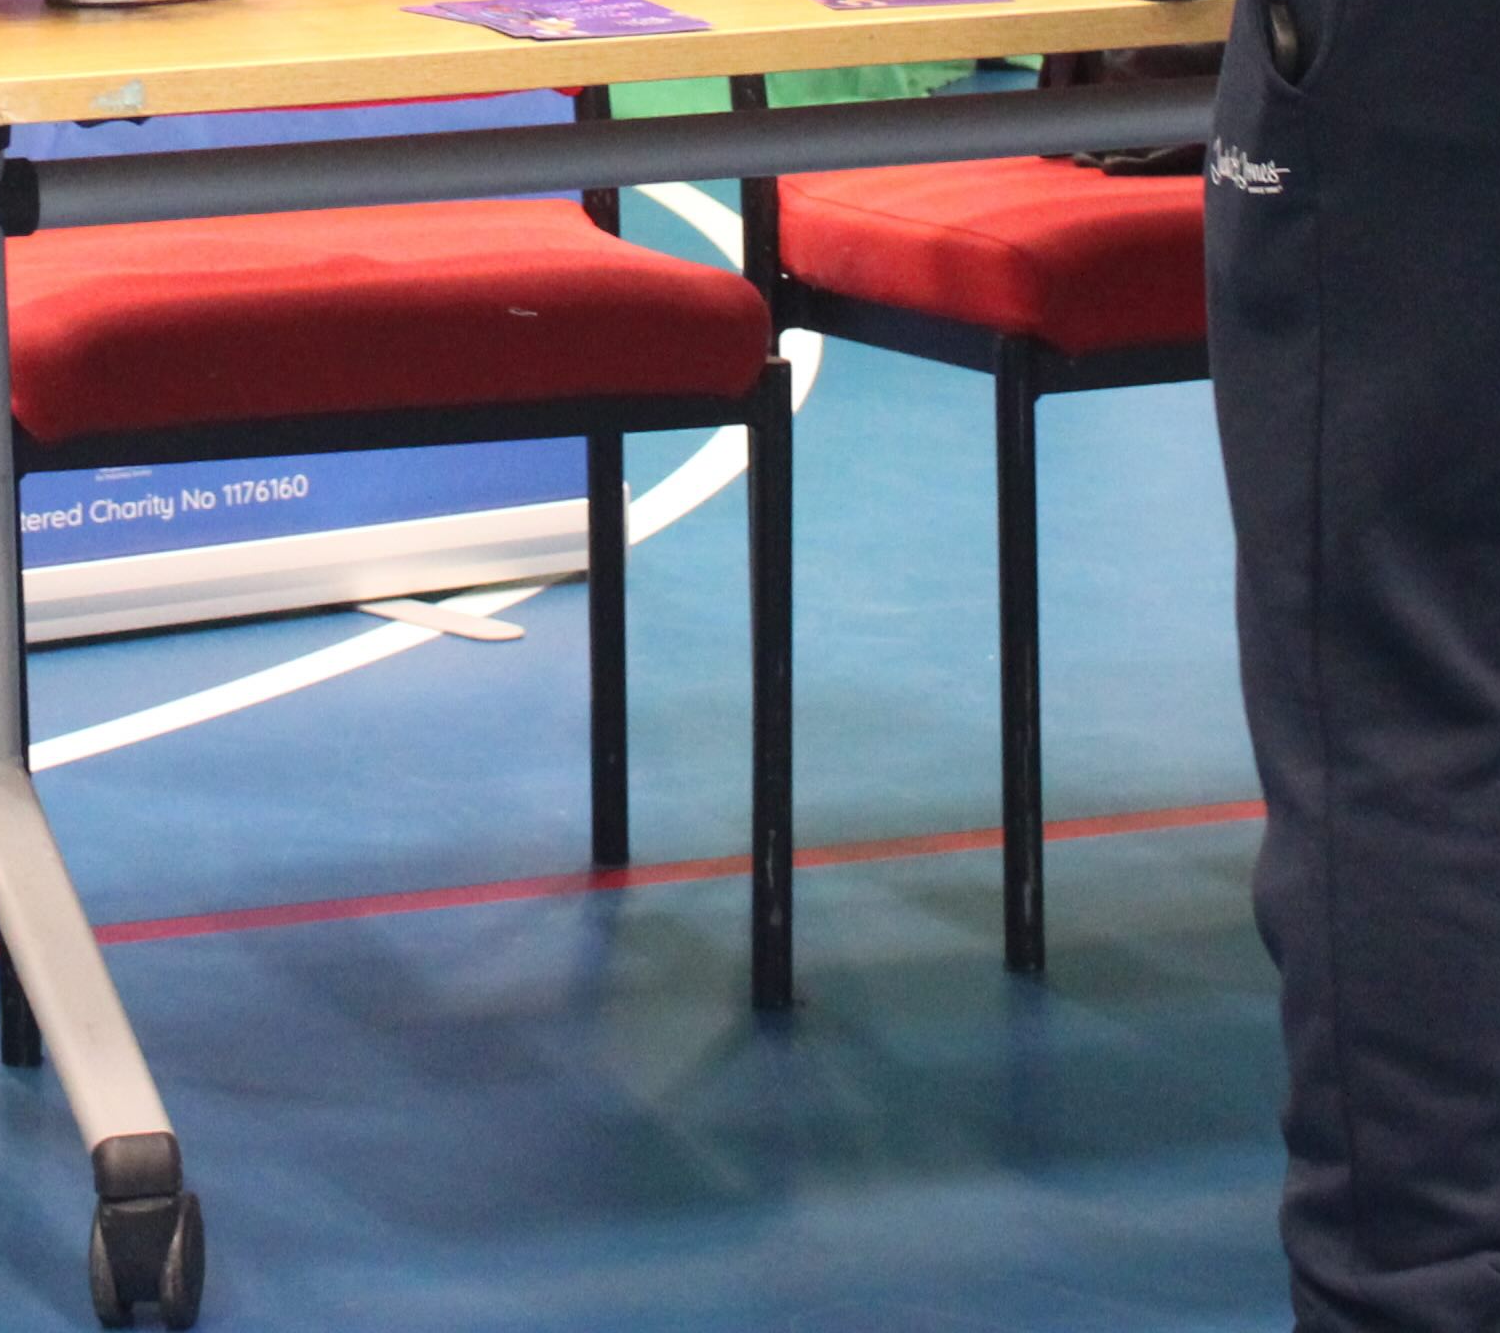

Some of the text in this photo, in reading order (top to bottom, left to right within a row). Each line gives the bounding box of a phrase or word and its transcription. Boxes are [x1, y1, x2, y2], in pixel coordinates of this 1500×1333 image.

[20, 473, 310, 532] tered Charity No 1176160
